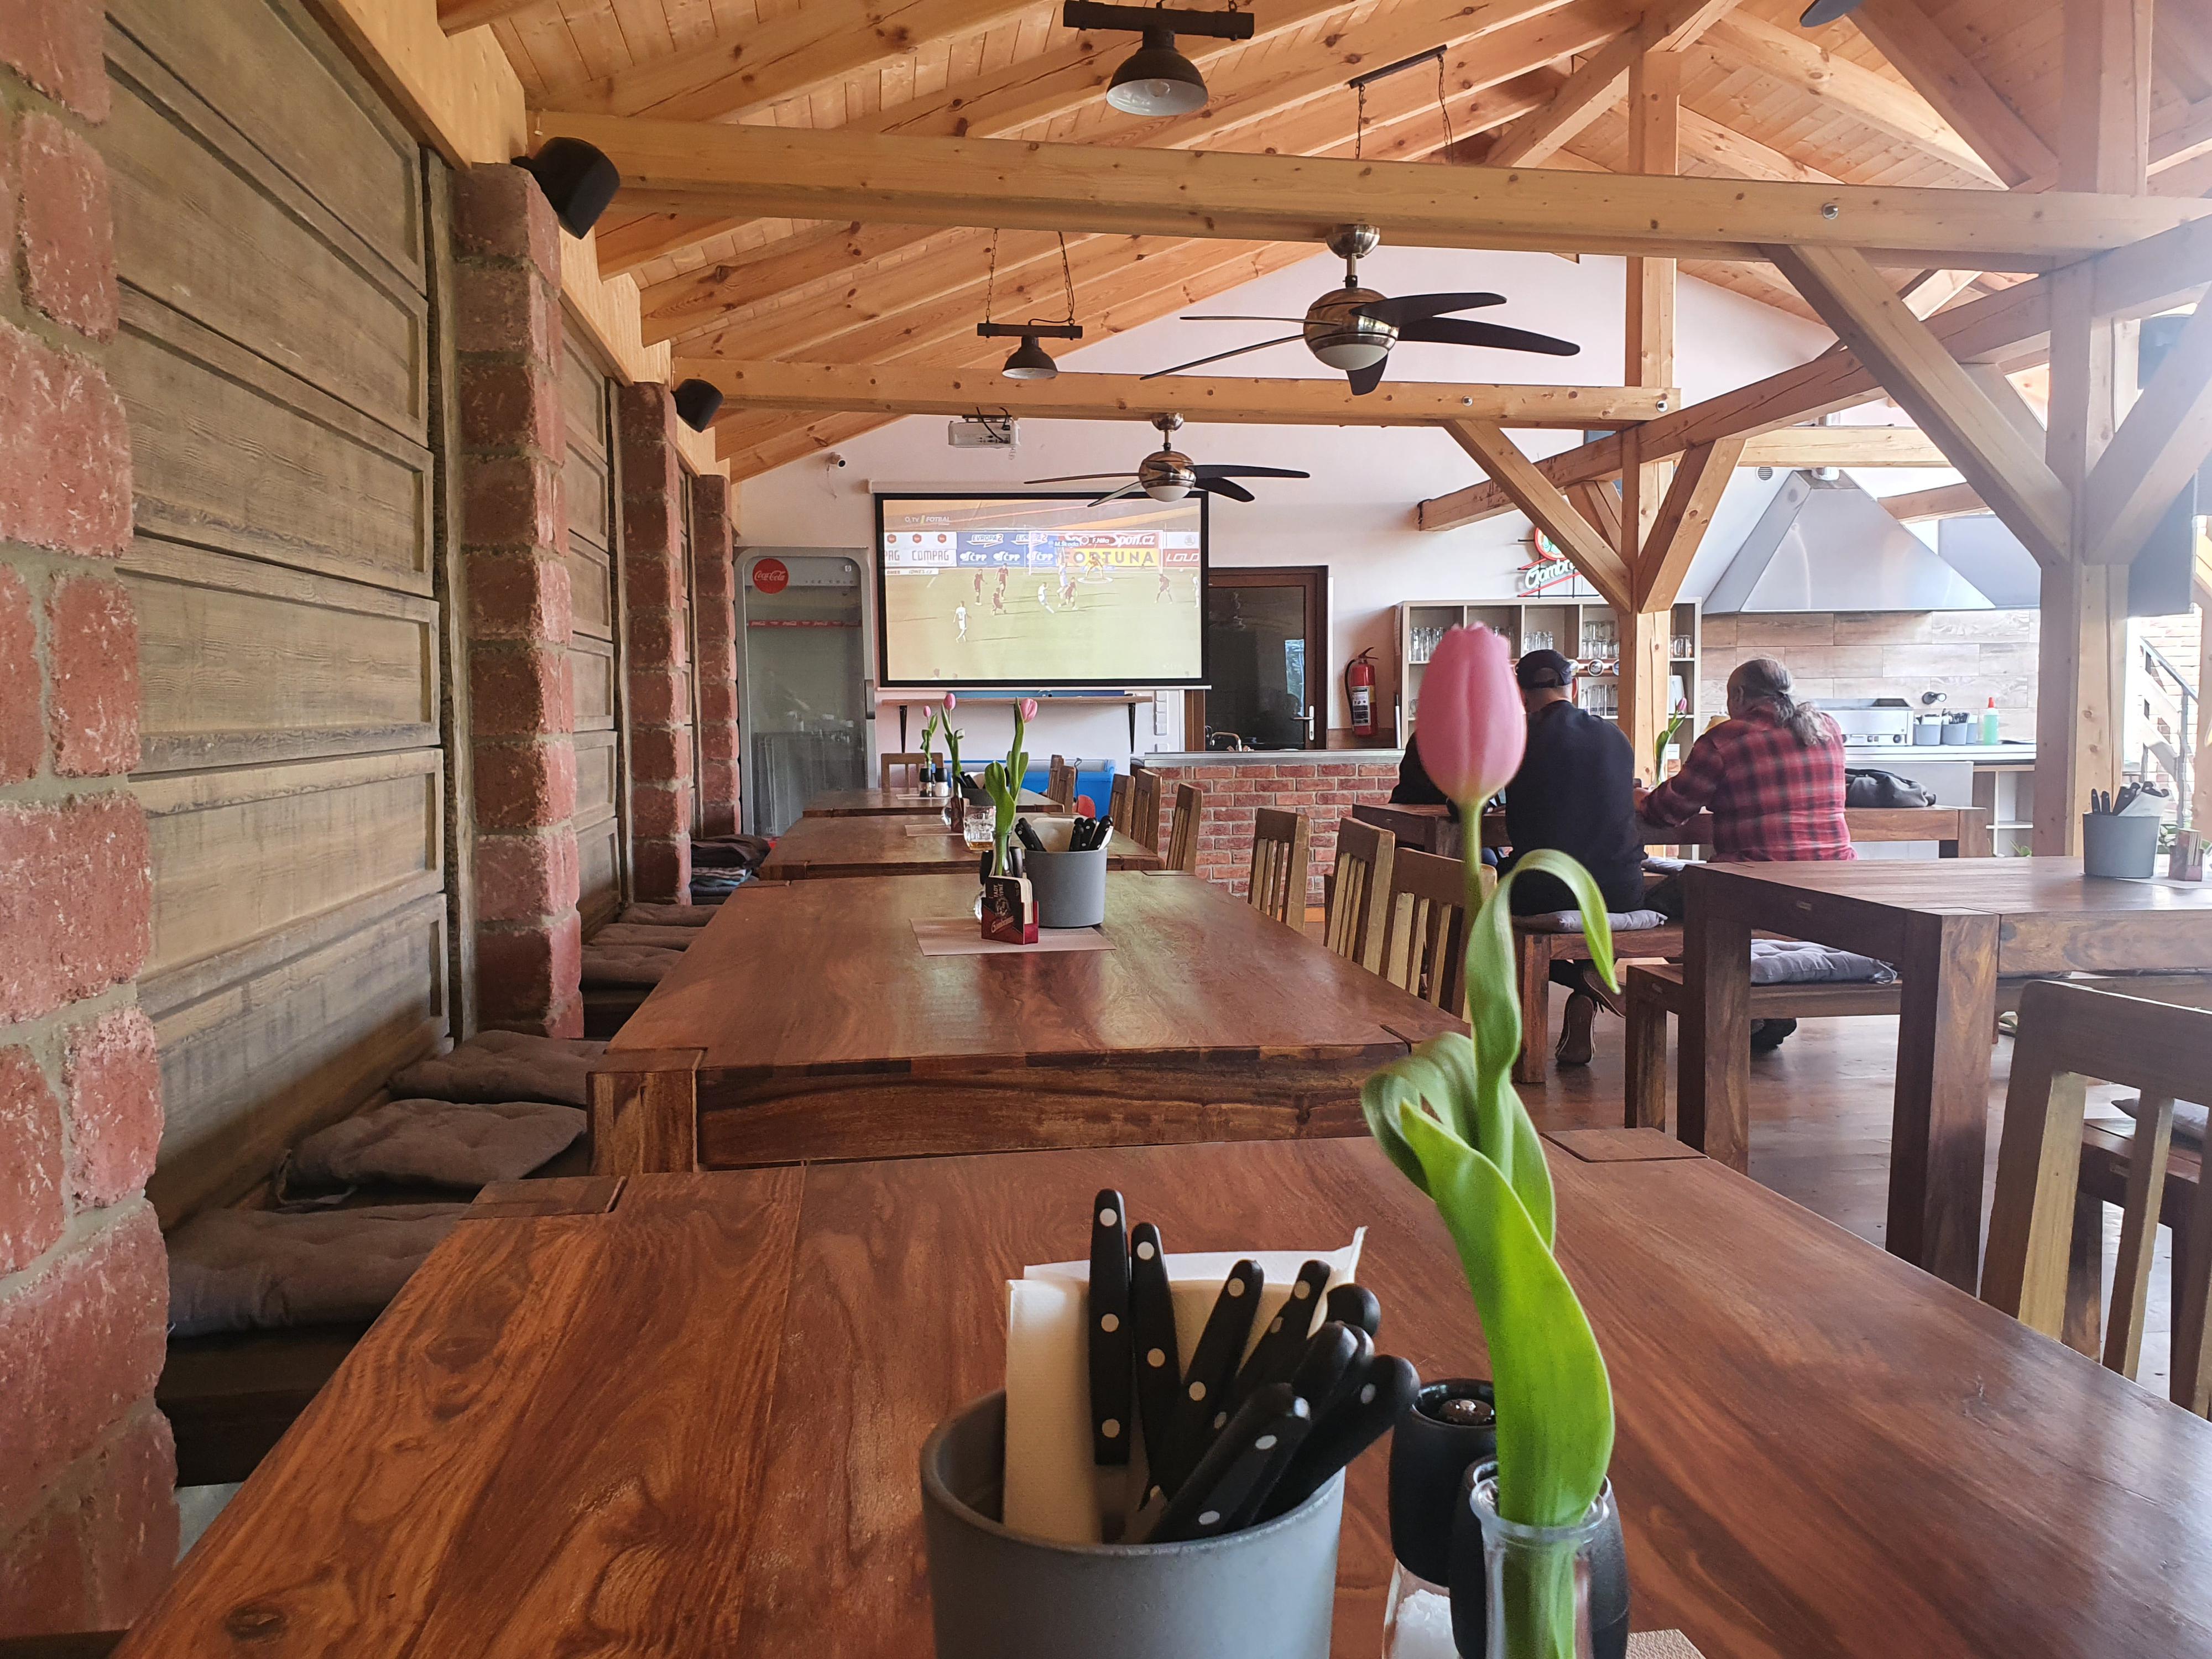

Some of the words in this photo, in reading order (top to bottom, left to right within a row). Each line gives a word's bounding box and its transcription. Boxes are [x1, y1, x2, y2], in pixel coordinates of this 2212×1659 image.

[997, 534, 1004, 542] 2
[912, 550, 950, 561] COMPAG
[754, 570, 786, 581] Coca-Cola
